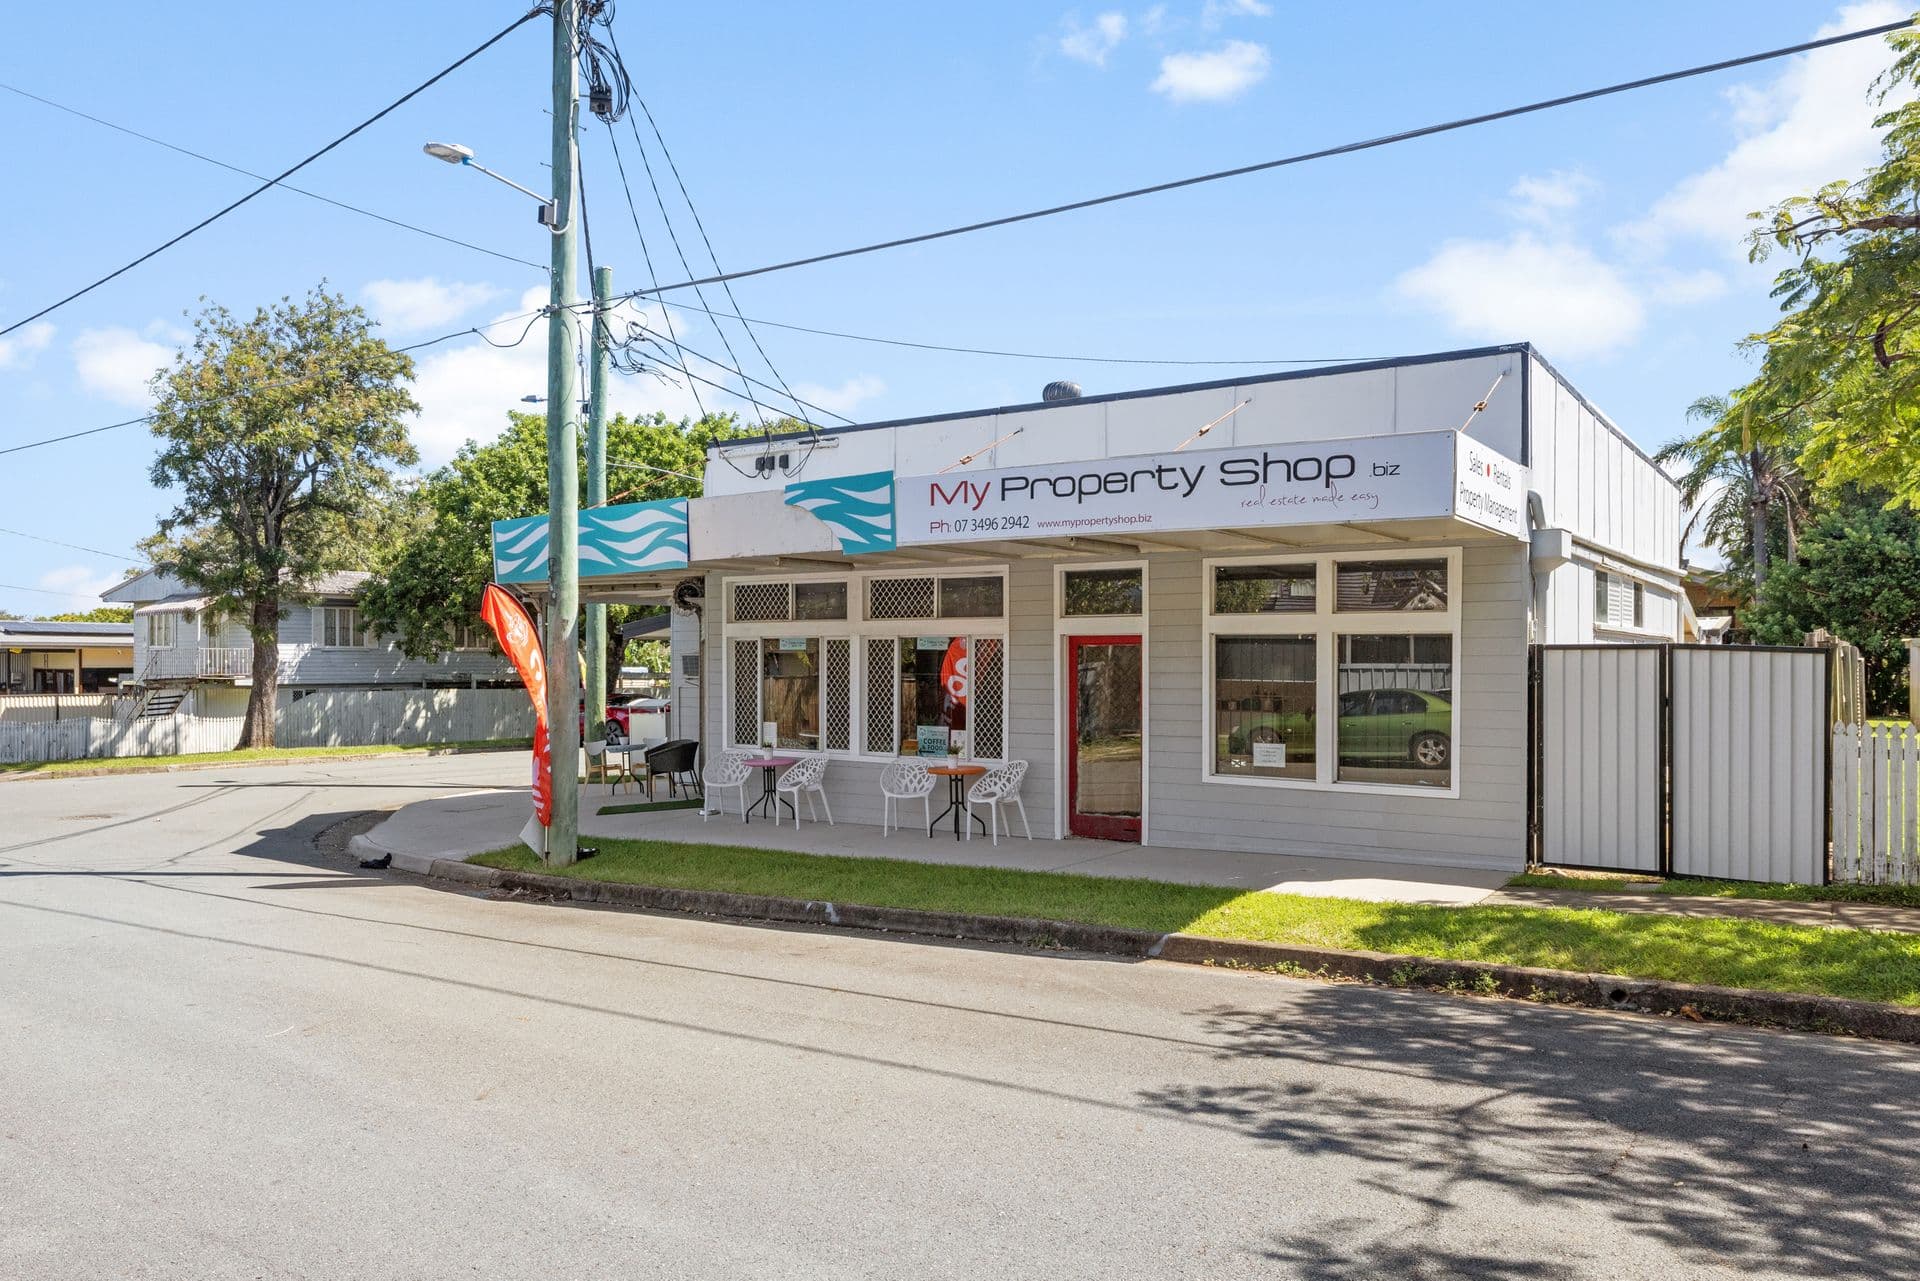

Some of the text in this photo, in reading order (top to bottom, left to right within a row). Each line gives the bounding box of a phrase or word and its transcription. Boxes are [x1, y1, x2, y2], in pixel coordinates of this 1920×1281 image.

[930, 480, 991, 511] My
[1001, 464, 1206, 504] Property
[1219, 452, 1356, 488] Shop
[1469, 451, 1511, 490] Sales Rentals
[1241, 480, 1379, 509] real estate made easy
[1460, 481, 1518, 524] Property Management
[930, 515, 1030, 533] Ph: 07 3496 2942
[1036, 513, 1152, 529] www.mypropertyshop.biz
